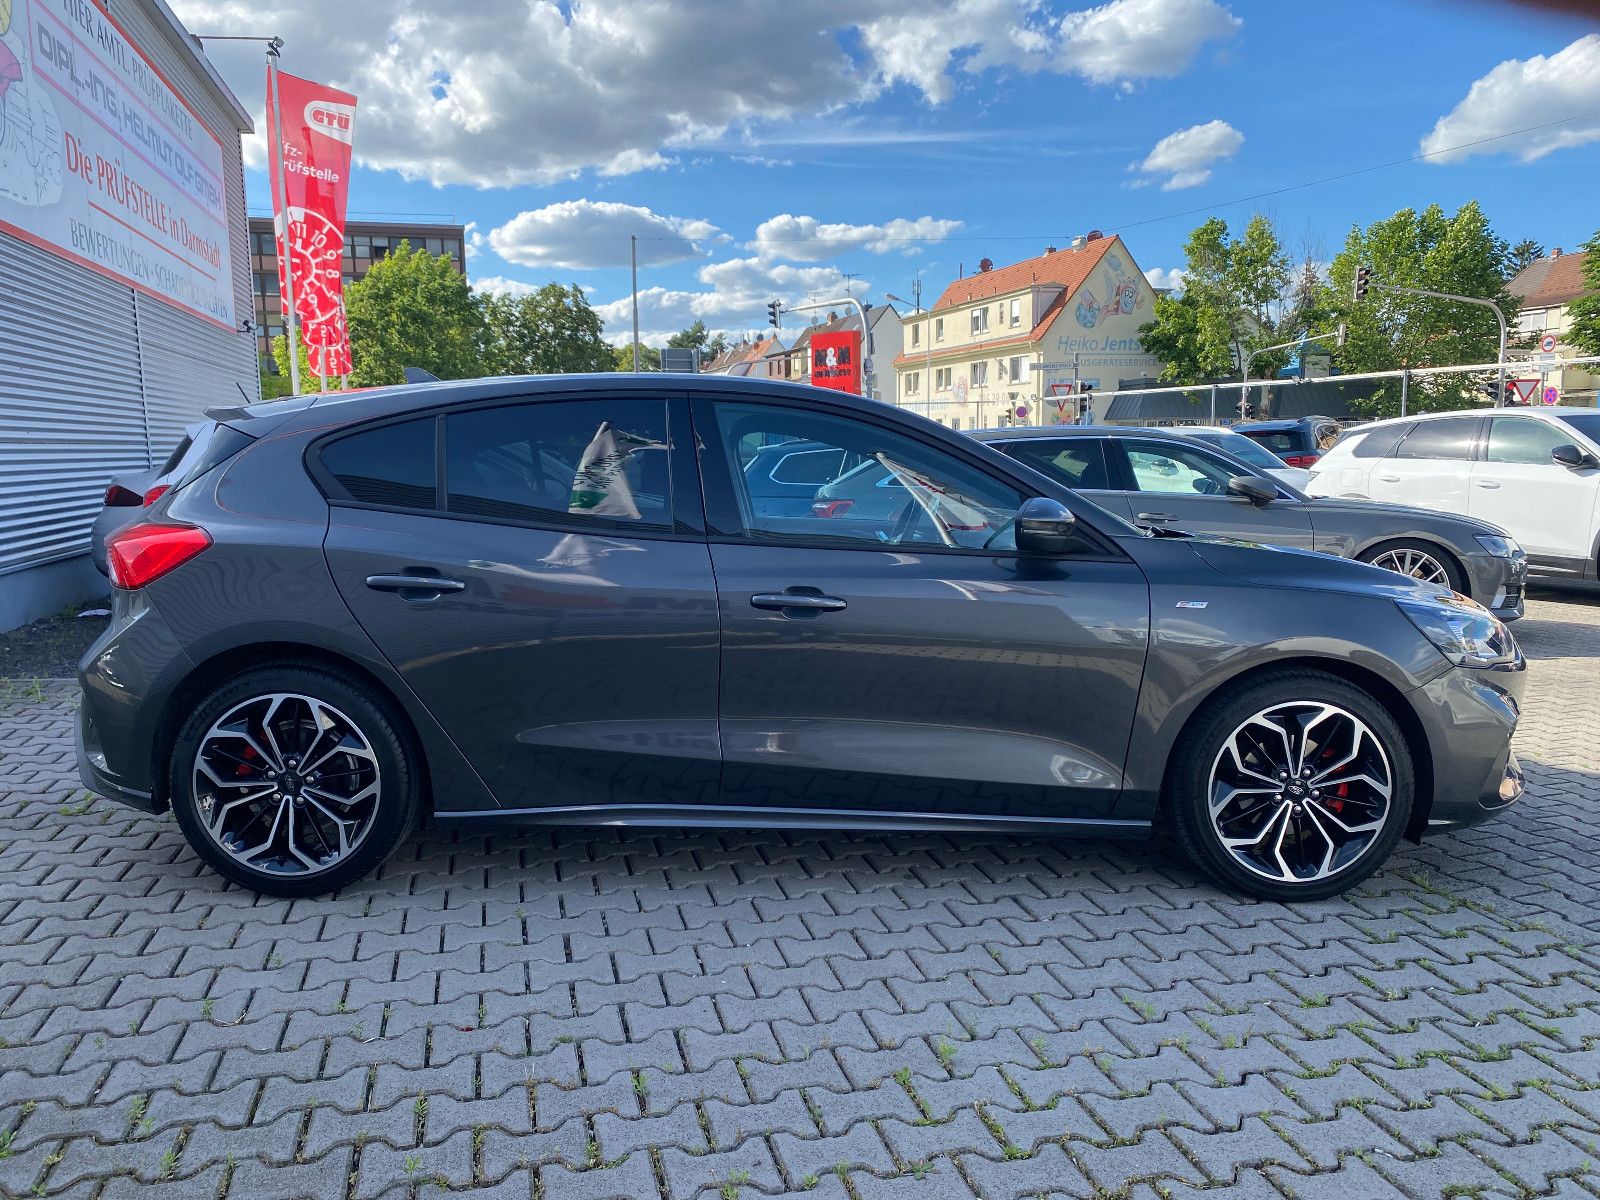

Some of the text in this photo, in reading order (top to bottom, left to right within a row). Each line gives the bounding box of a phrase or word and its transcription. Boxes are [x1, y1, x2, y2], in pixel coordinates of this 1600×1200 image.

[97, 19, 130, 76] AMTL.
[132, 57, 193, 141] PRÜFPLAKETTE
[312, 108, 350, 131] GTÜ
[122, 102, 173, 167] HELMUT
[282, 140, 303, 157] fz-
[283, 159, 339, 183] rüfstelle
[64, 130, 222, 271] Die PRÜFSTELLE in Darmstadt
[70, 218, 150, 282] BEWERTUNGEN
[310, 229, 328, 249] 10
[325, 268, 340, 279] 8
[1057, 335, 1143, 353] Heiko Jents
[814, 345, 851, 368] M&M
[1069, 357, 1158, 367] USGERÄTESERVICE
